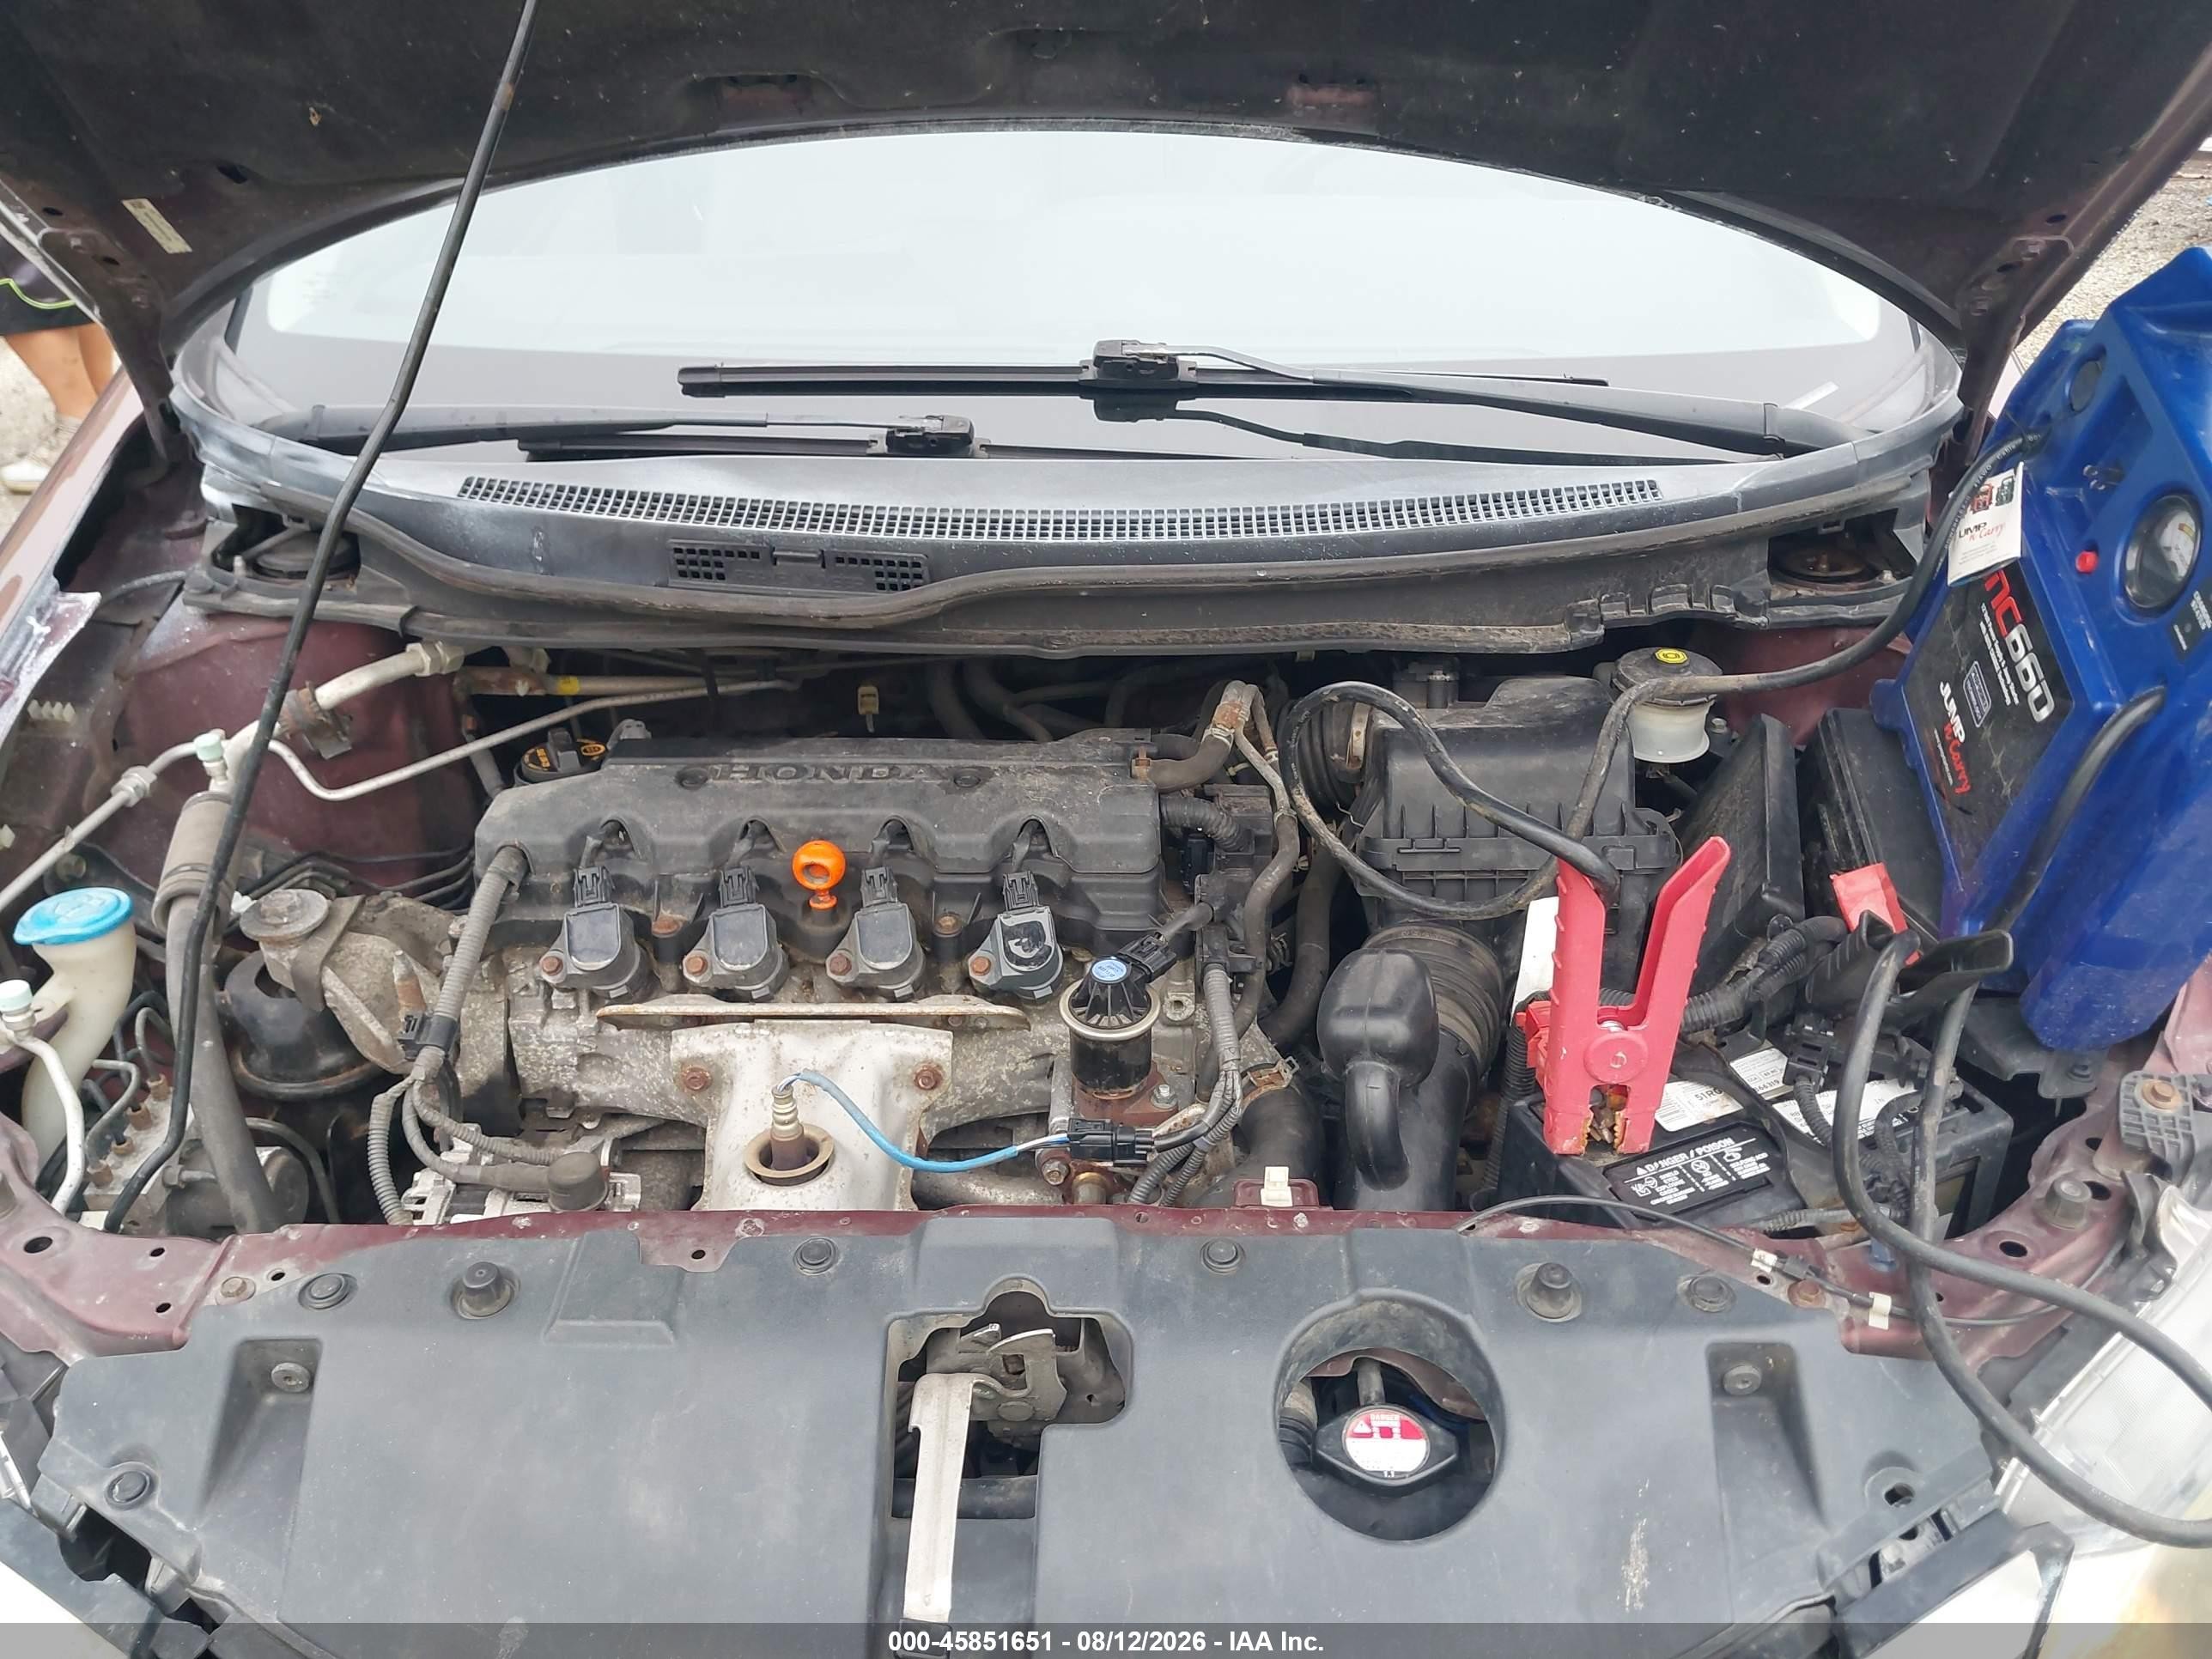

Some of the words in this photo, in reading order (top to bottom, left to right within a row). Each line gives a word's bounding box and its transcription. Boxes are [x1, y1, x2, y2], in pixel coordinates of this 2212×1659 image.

[1958, 521, 1988, 538] UMP
[1984, 568, 2055, 723] NC660
[1939, 681, 1966, 744] JUMP
[707, 763, 946, 784] HONDA
[1695, 1137, 1735, 1156] POISON
